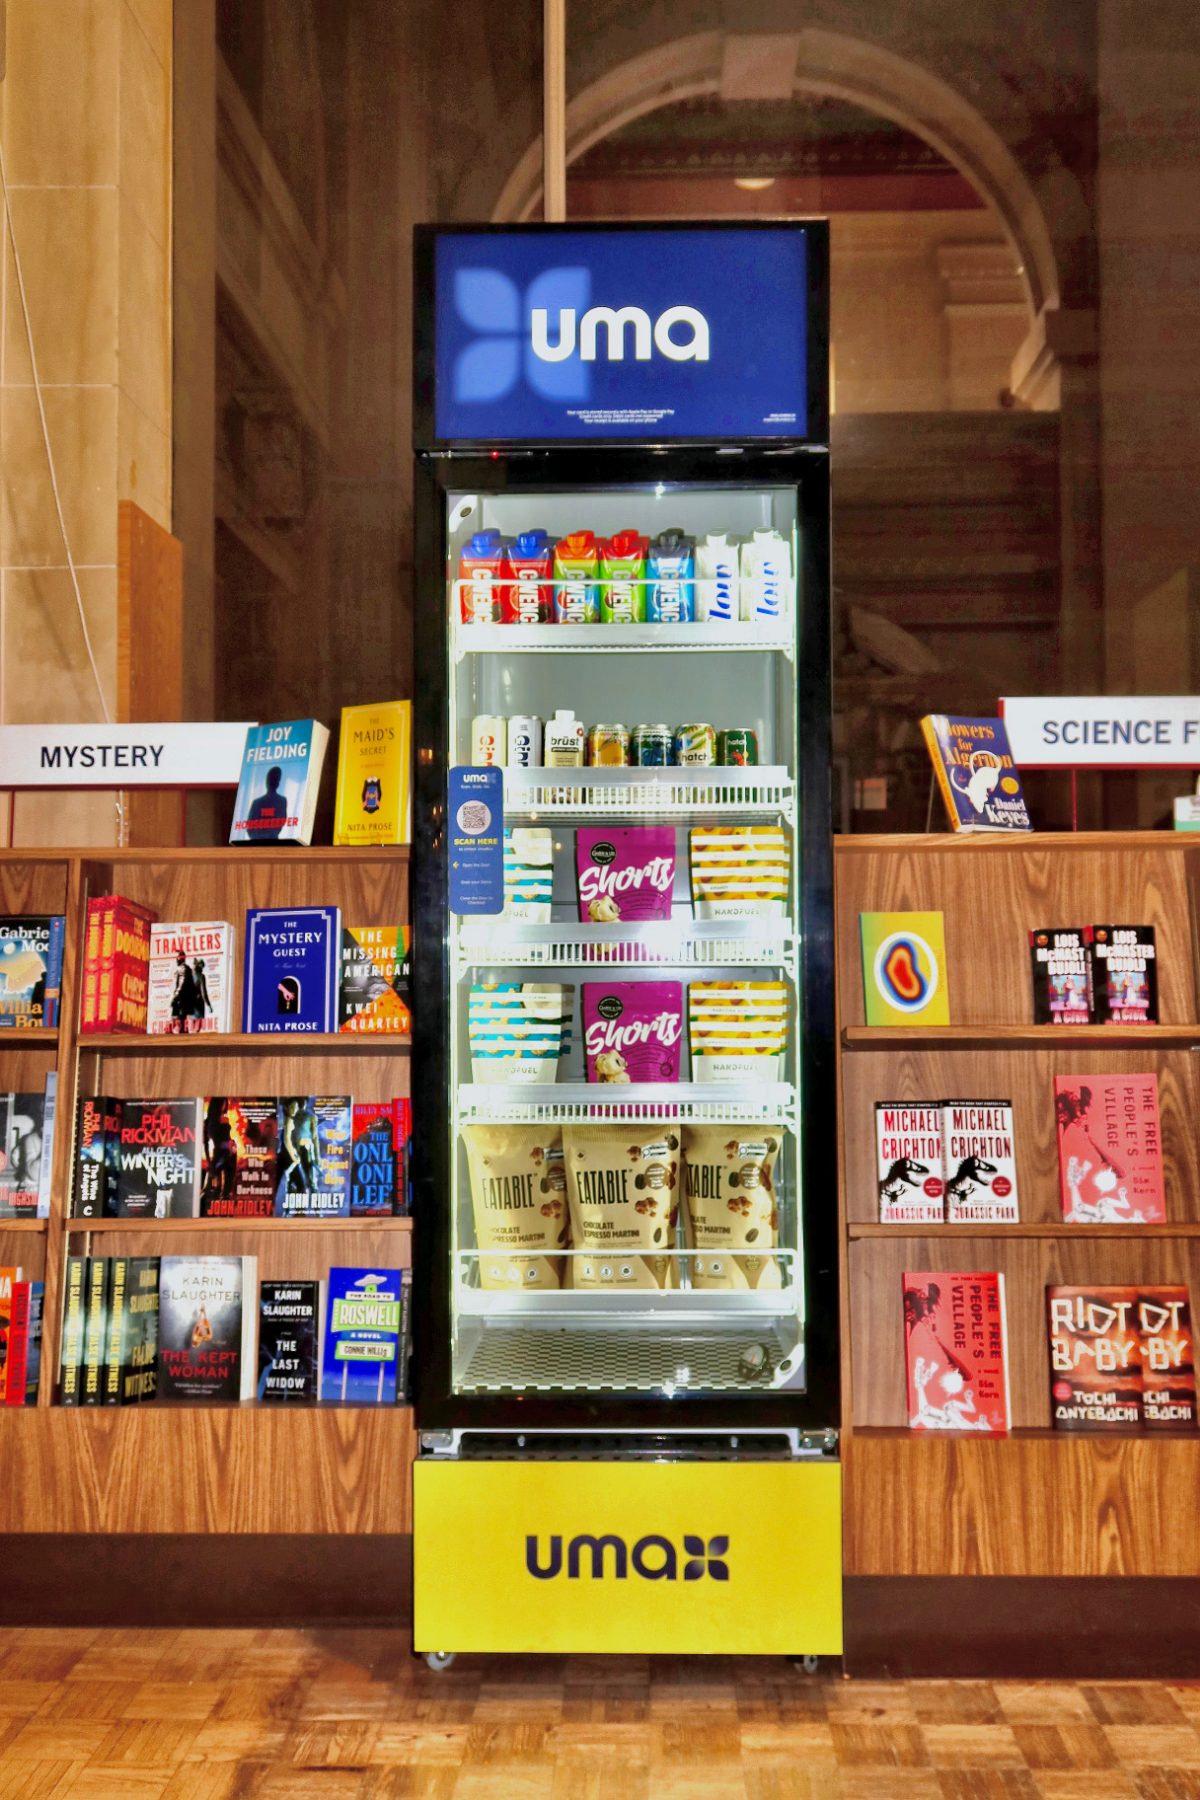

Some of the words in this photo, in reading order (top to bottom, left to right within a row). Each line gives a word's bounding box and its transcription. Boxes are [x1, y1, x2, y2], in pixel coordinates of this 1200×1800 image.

[541, 305, 719, 362] uma
[266, 726, 293, 743] JOY
[353, 728, 395, 744] MAID'S
[1043, 720, 1172, 745] SCIENCE
[360, 745, 387, 757] SECRET
[958, 738, 974, 751] for
[40, 745, 164, 768] MYSTERY
[247, 743, 308, 763] FIELDING
[463, 774, 487, 783] uma
[994, 797, 1025, 811] Daniel
[985, 803, 1030, 827] Keyes
[235, 816, 299, 830] HOUSEKEEPER
[346, 822, 366, 832] NITA
[368, 821, 393, 832] PROSE
[454, 838, 475, 846] SCAN
[477, 838, 498, 846] HERE
[579, 856, 676, 902] Shorts
[0, 926, 50, 939] Gabrie
[258, 932, 322, 944] MYSTERY
[360, 930, 383, 943] THE
[1113, 930, 1138, 945] LOIS
[155, 933, 222, 955] TRAVELERS
[1054, 934, 1079, 948] LOIS
[273, 948, 306, 957] GUEST
[342, 948, 398, 960] MISSING
[344, 963, 410, 978] AMERICAN
[345, 1003, 377, 1014] KWEI
[258, 1022, 281, 1031] NITA
[284, 1021, 318, 1031] PROSE
[585, 1011, 683, 1056] Shorts
[1142, 1087, 1155, 1112] THE
[82, 1101, 95, 1148] RICKMAN
[142, 1114, 171, 1130] PHIL
[884, 1110, 940, 1132] MICHAEL
[952, 1109, 1007, 1131] MICHAEL
[1104, 1088, 1119, 1148] VILLAGE
[1123, 1087, 1139, 1157] PEOPLE'S
[121, 1128, 195, 1145] RICKMAN
[370, 1131, 389, 1140] THE
[1144, 1121, 1158, 1156] FREE
[246, 1144, 267, 1155] Those
[951, 1136, 1012, 1159] CRICHTON
[147, 1167, 194, 1186] NIGHT
[236, 1185, 273, 1195] Darkness
[482, 1173, 535, 1210] EATABLE
[576, 1169, 629, 1205] EATABLE
[207, 1200, 234, 1215] JOHN
[236, 1200, 273, 1215] RIDLEY
[283, 1193, 310, 1209] JOHN
[311, 1192, 345, 1208] RIDLEY
[996, 1207, 1015, 1219] PARK
[584, 1230, 611, 1239] ESPRESSO
[612, 1229, 640, 1238] MARTINI
[182, 1276, 223, 1286] KARIN
[162, 1289, 240, 1301] SLAUGHTER
[274, 1290, 302, 1301] KARIN
[986, 1286, 997, 1313] THE
[263, 1305, 313, 1316] SLAUGHTER
[340, 1304, 399, 1327] ROSWELL
[951, 1285, 966, 1349] VILLAGE
[969, 1285, 984, 1359] PEOPLE'S
[276, 1340, 297, 1352] THE
[989, 1322, 1002, 1359] FREE
[161, 1350, 190, 1363] THE
[197, 1351, 237, 1364] KEPT
[344, 1345, 366, 1355] CONNIE
[1052, 1337, 1136, 1371] BABY
[168, 1365, 228, 1378] WOMAN
[272, 1359, 299, 1370] LAST
[266, 1377, 305, 1389] WIDOW
[1073, 1390, 1116, 1404] TOCHI
[526, 1534, 677, 1580] uma
